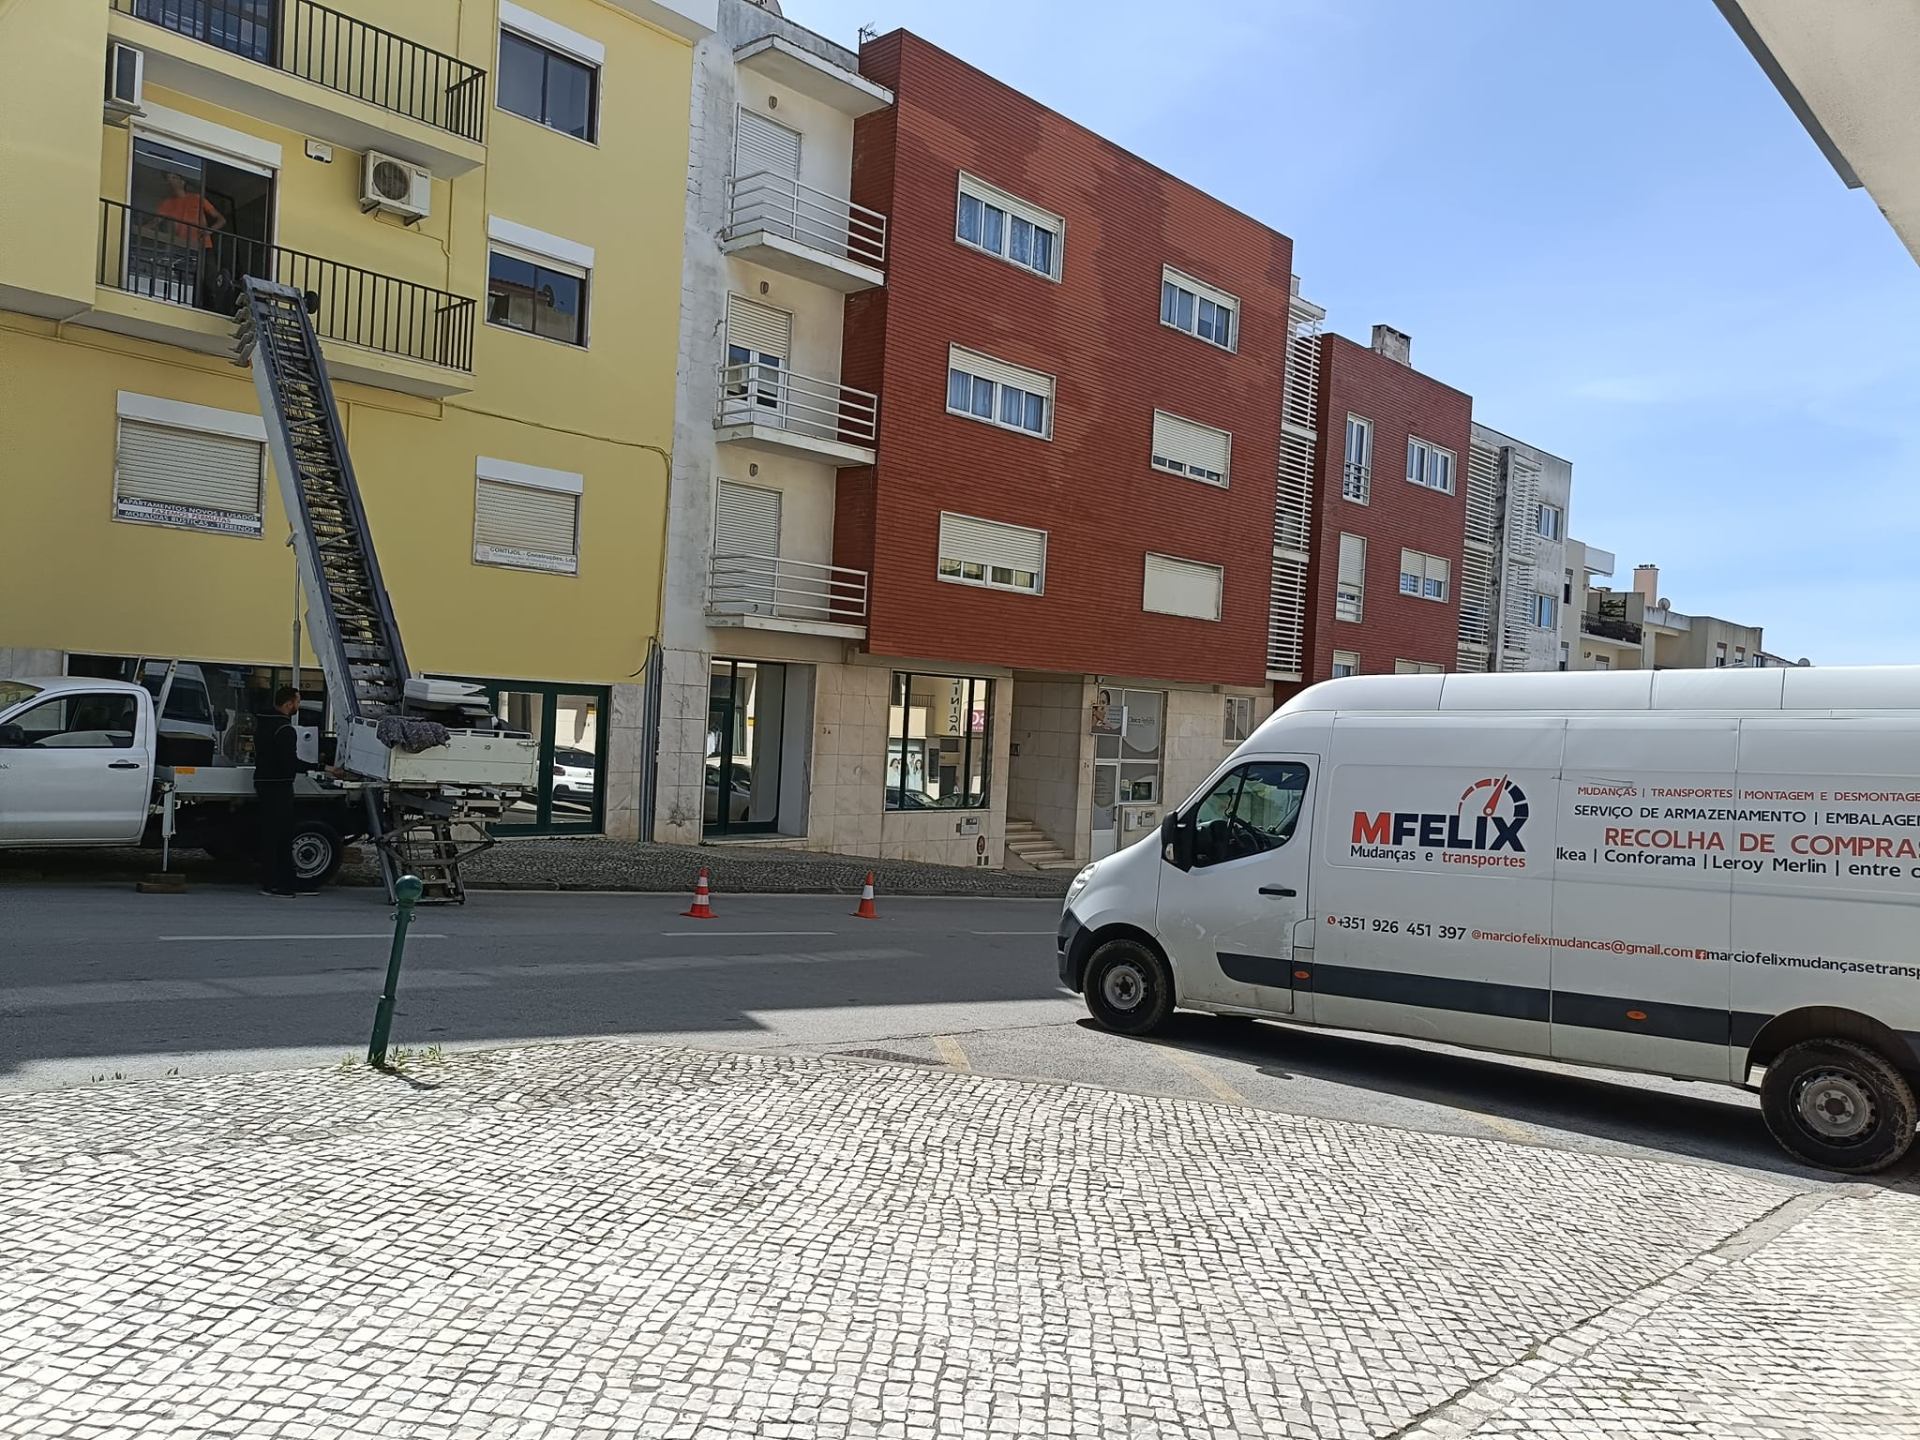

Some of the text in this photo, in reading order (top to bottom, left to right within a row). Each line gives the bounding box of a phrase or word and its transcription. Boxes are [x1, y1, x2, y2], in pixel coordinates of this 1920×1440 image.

[122, 498, 187, 512] APARTAMENTOS
[189, 508, 217, 517] NOVOS
[226, 512, 259, 521] USADOS
[125, 510, 169, 522] MORADIAS
[215, 523, 256, 534] TERRENOS
[1577, 786, 1637, 799] MUDANÇAS
[1651, 788, 1733, 799] TRANSPORTES
[1744, 790, 1814, 802] MONTAGEM
[1820, 792, 1828, 801] E
[1574, 804, 1920, 827] SERVIÇO DE ARMAZENAMENTO EMBALAGE
[1351, 810, 1528, 853] MFELIX
[1604, 827, 1920, 860] RECOLHA DE COMPRA
[1350, 844, 1526, 868] Mudanças e transportes
[1556, 846, 1587, 862] Ikea
[1604, 849, 1697, 868] Conforama
[1712, 854, 1764, 874] Leroy
[1773, 857, 1827, 874] Merlin
[1849, 862, 1901, 878] entre
[1337, 916, 1366, 931] +351
[1372, 919, 1400, 934] 926
[1406, 922, 1432, 937] 451
[1438, 925, 1467, 941] 397
